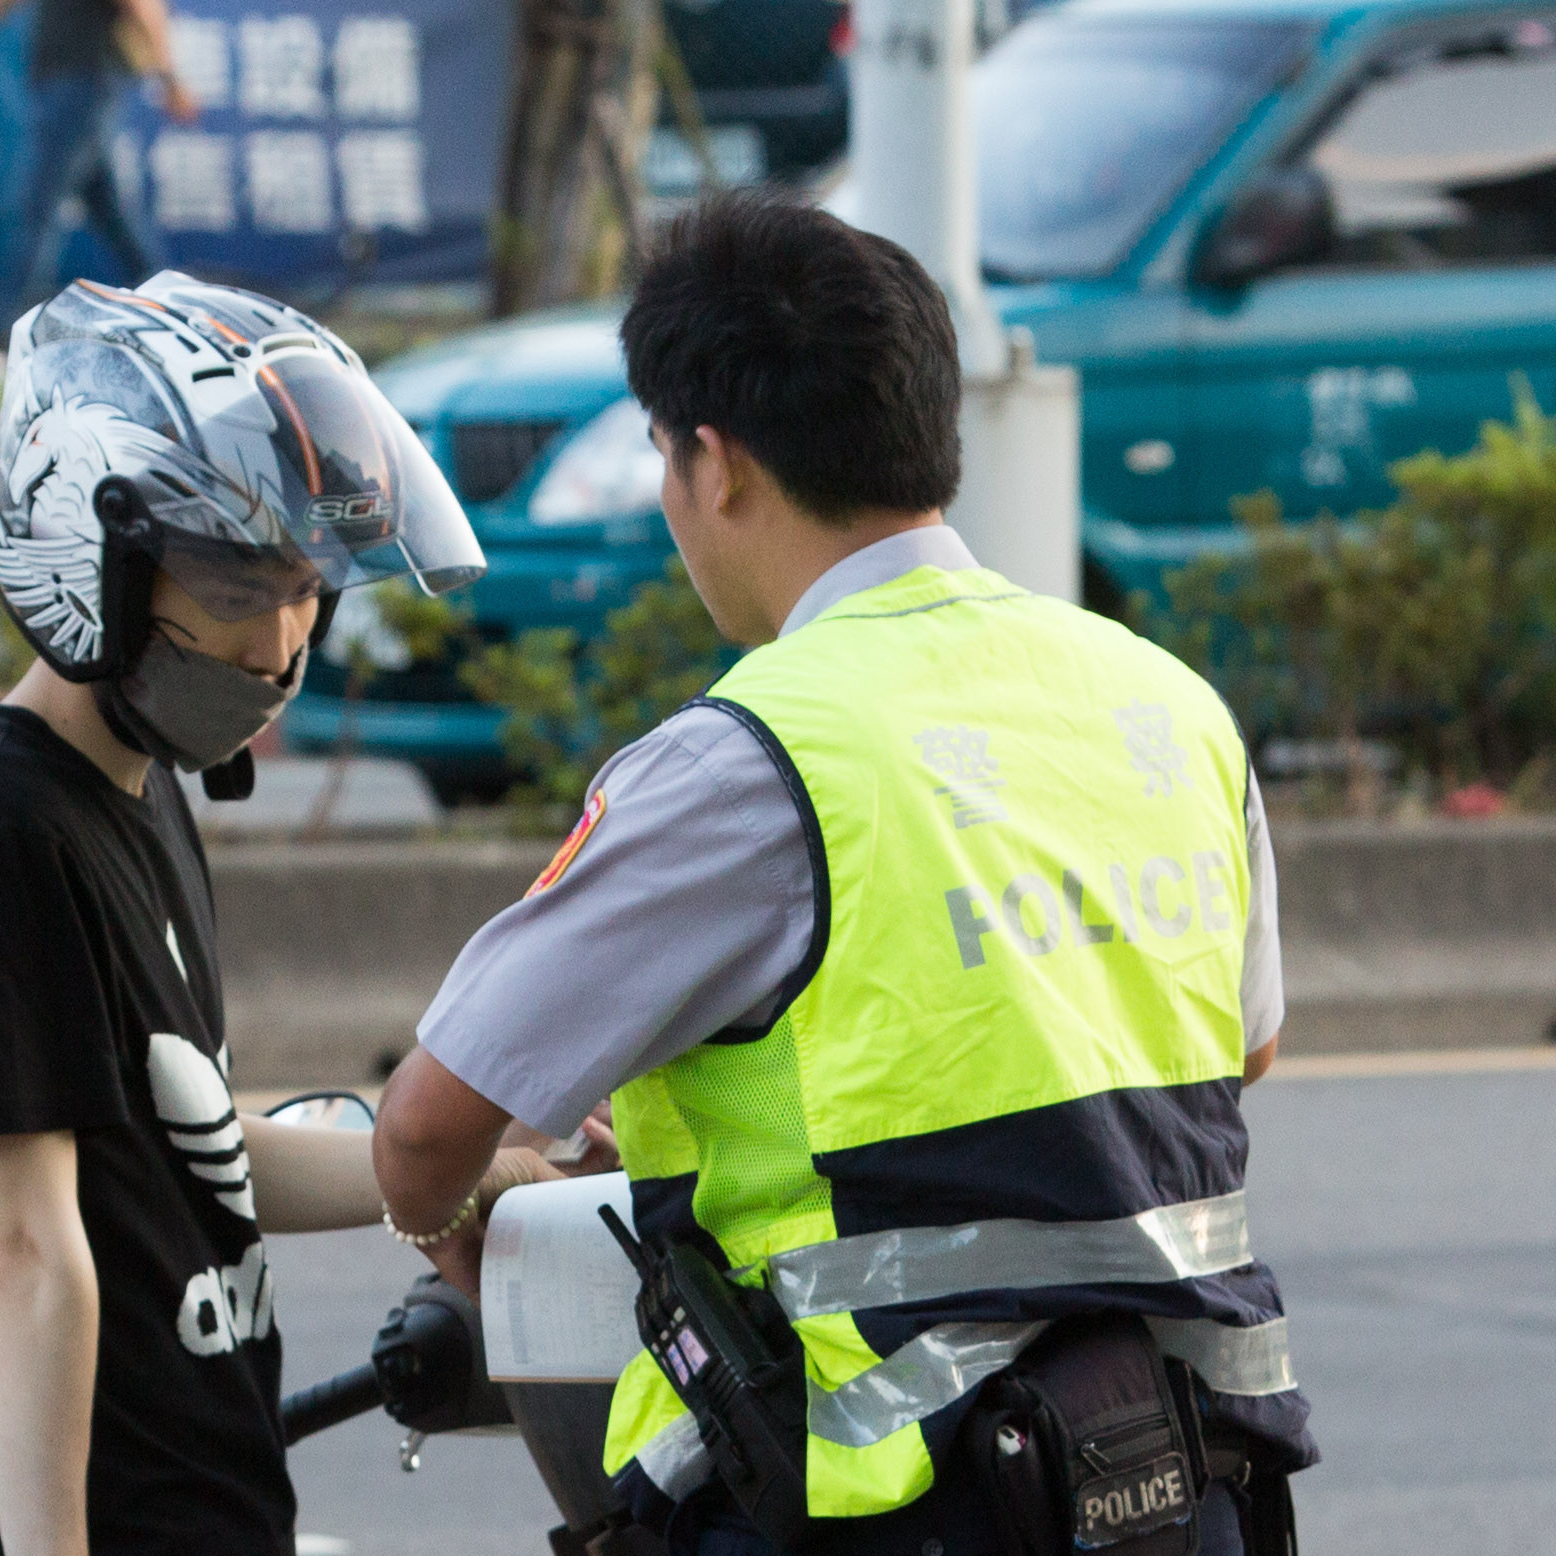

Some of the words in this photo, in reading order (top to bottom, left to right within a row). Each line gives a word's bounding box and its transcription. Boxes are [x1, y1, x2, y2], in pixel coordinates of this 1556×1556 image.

[912, 698, 1195, 830] 警察
[944, 850, 1231, 970] POLICE
[1085, 1469, 1184, 1531] POLICE
